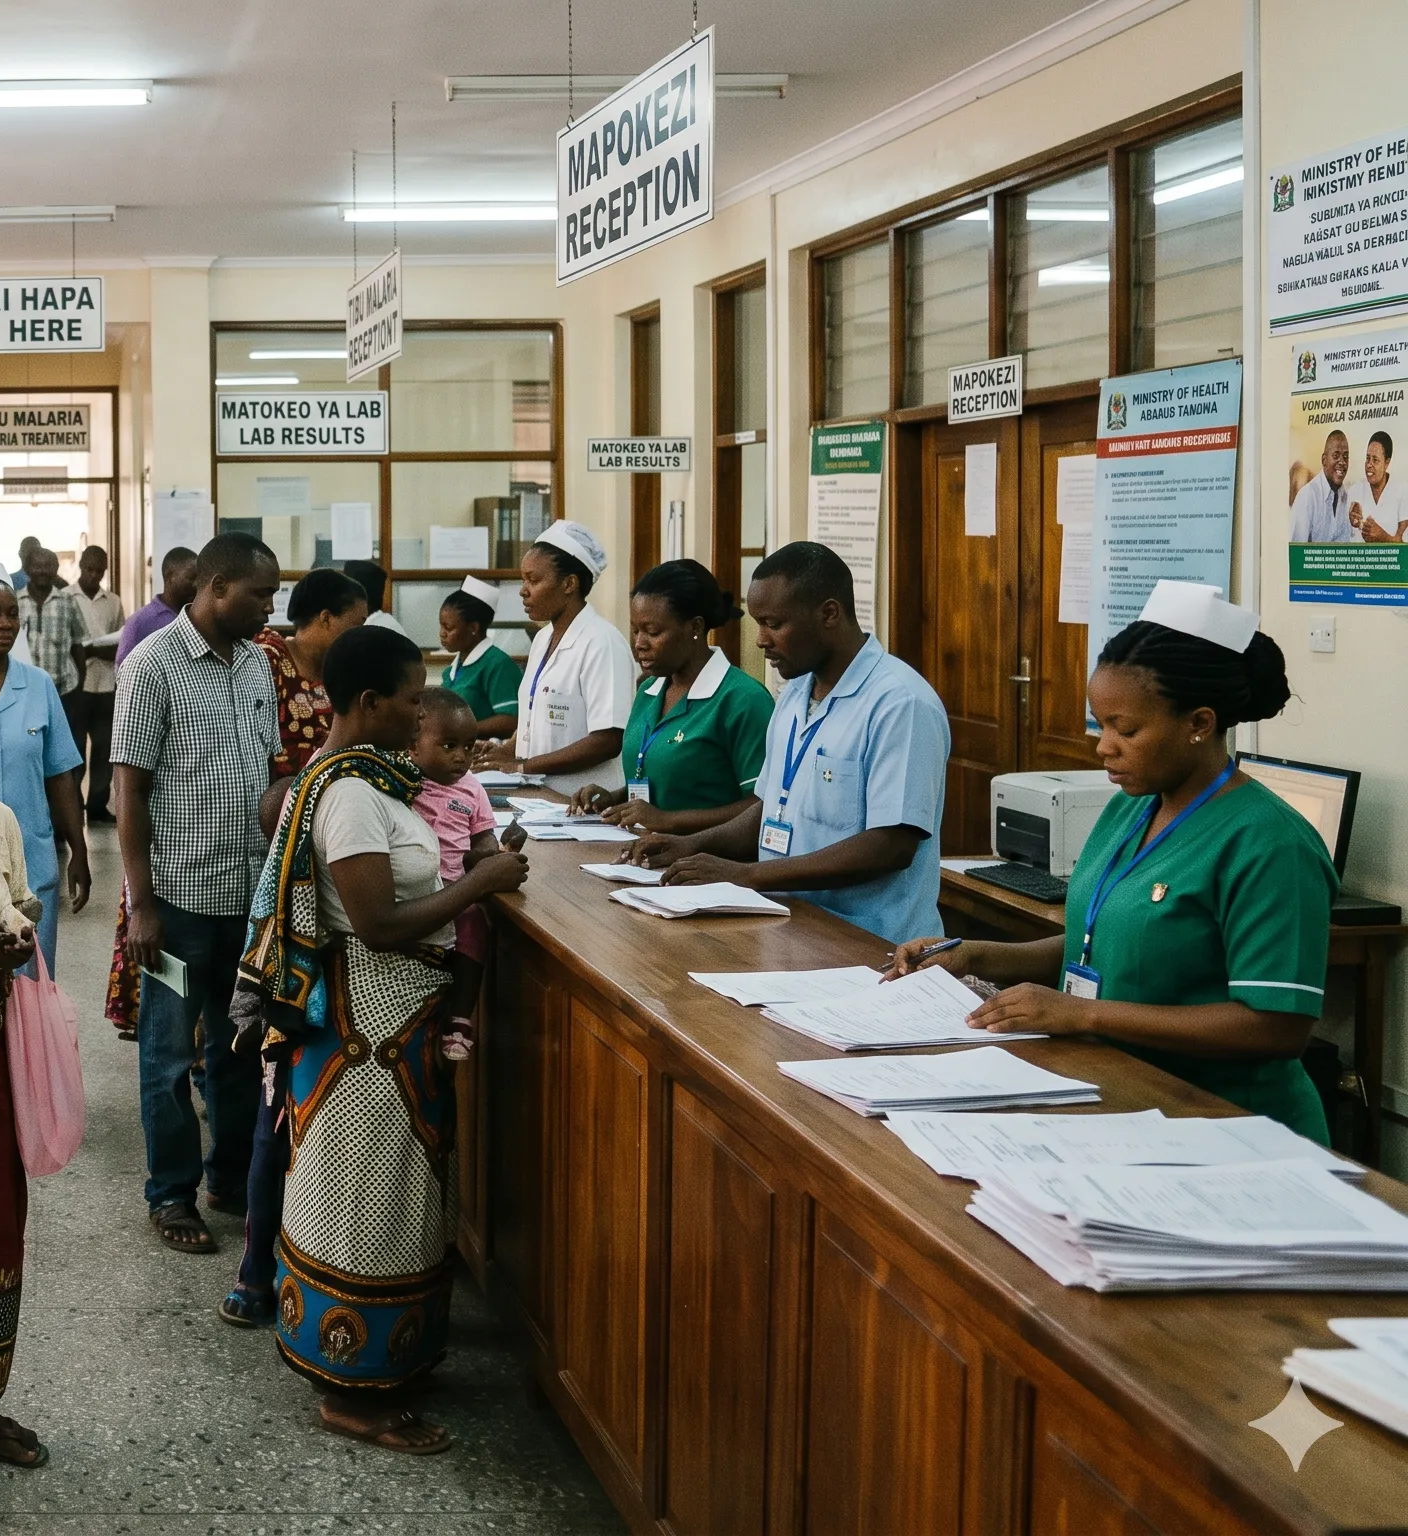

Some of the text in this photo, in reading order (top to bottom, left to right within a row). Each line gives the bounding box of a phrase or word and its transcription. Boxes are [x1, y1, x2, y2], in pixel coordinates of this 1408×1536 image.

[568, 63, 696, 197] MAPOKEZI
[1301, 139, 1408, 183] MINISTRY OF HE
[566, 143, 700, 264] RECEPTION
[1357, 198, 1371, 212] YA
[1346, 241, 1361, 254] SA
[21, 286, 95, 311] HAPA
[348, 291, 365, 329] TIBU
[9, 318, 83, 342] HERE
[1323, 348, 1362, 362] MINISTRY
[1363, 346, 1376, 357] OF
[952, 364, 1016, 393] MAPOKEZI
[952, 388, 1017, 416] RECEPTION
[1132, 380, 1230, 406] MINISTRY OF HEALTH
[13, 410, 83, 427] MALARIA
[221, 400, 382, 420] MATOKEO YA LAB
[21, 431, 87, 446] TREATMENT
[240, 426, 365, 446] LAB RESULTS
[591, 442, 687, 453] MATOKEO YA LAB
[598, 456, 681, 467] LAB RESULTS
